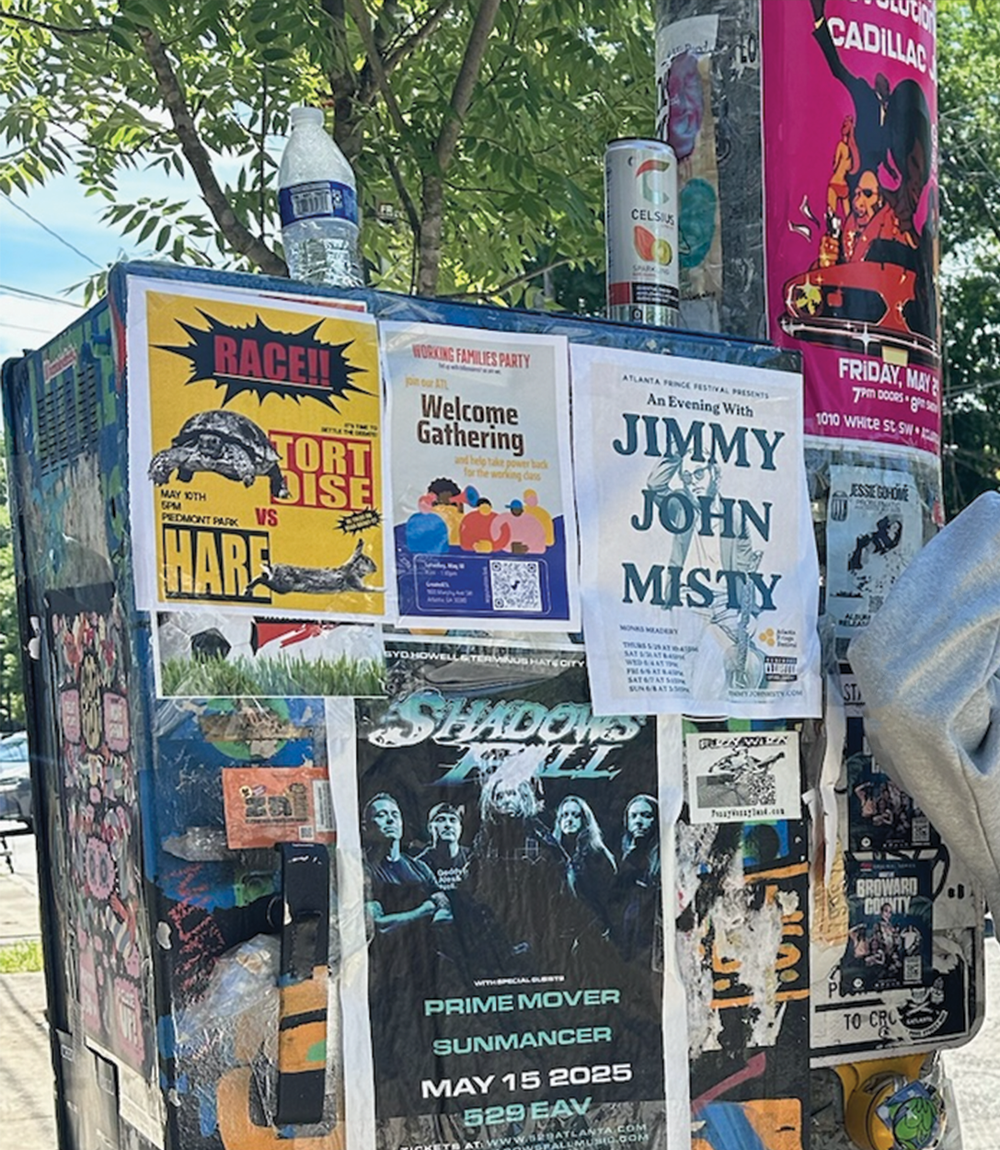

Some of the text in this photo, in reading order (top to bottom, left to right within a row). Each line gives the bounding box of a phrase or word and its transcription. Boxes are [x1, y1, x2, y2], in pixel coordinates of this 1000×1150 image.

[631, 208, 675, 226] CELSIUS
[214, 335, 330, 387] RACE!!
[412, 344, 531, 368] WORKING FAMILIES PARTY
[623, 374, 770, 400] ATLANTA FRINGE FESTIVAL PRESENTS
[906, 368, 931, 393] MAY
[420, 393, 519, 425] Welcome
[647, 393, 754, 418] An Evening With
[815, 412, 841, 426] 1010
[417, 419, 525, 457] Gathering
[612, 412, 785, 471] JIMMY
[270, 433, 371, 477] TORT
[161, 489, 206, 501] MAY 10TH
[162, 512, 239, 527] PIEDMONT PARK
[255, 507, 279, 527] VS
[631, 488, 773, 542] JOHN
[165, 528, 269, 598] HARE
[621, 562, 782, 611] MISTY
[559, 660, 586, 668] CITY
[856, 877, 918, 898] BROWARD
[497, 976, 531, 986] SPECIAL
[531, 975, 565, 984] GUESTS
[424, 989, 621, 1016] PRIME MOVER
[844, 1013, 862, 1031] TO
[433, 1027, 612, 1056] SUNMANCER
[421, 1064, 633, 1099] MAY 15 2025
[464, 1097, 593, 1127] 529 EAV
[465, 1140, 484, 1150] AT:
